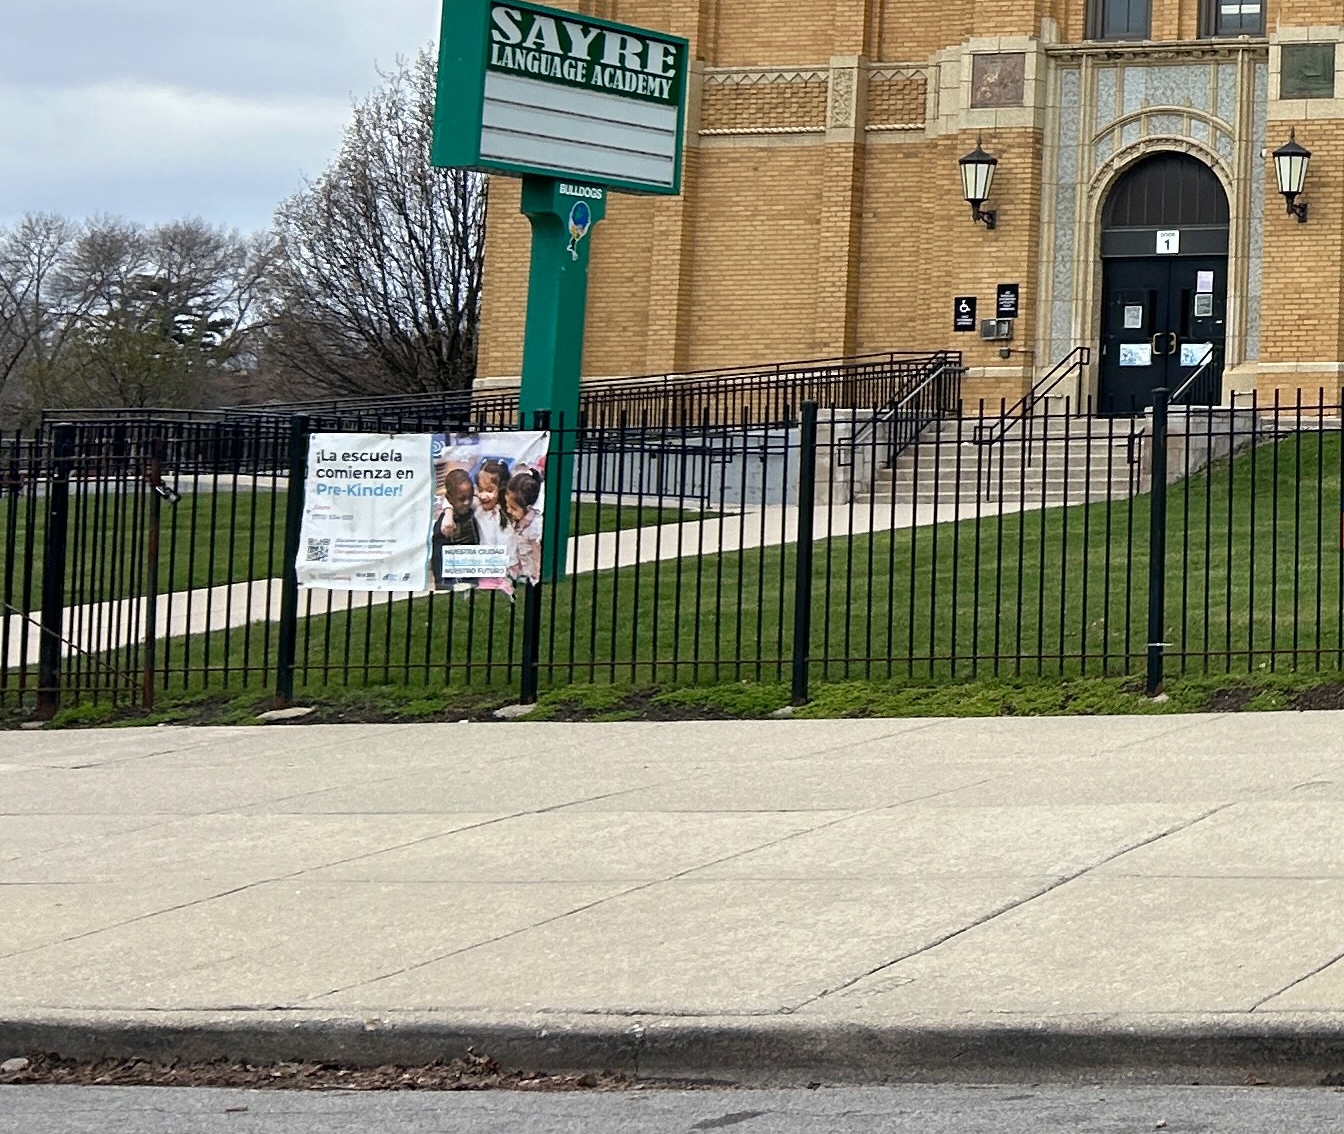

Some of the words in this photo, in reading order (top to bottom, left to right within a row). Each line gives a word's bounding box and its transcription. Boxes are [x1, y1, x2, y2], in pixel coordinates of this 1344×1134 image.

[491, 6, 677, 78] SAYRE
[490, 43, 587, 84] LANGUAGE
[591, 64, 672, 99] ACADEMY
[559, 183, 602, 199] BULLDOGS
[1164, 239, 1169, 250] 1
[316, 449, 337, 463] ¡La
[341, 449, 403, 462] escuela
[316, 466, 392, 479] comienza
[396, 469, 414, 479] en
[316, 483, 403, 496] Pre-Kinder!
